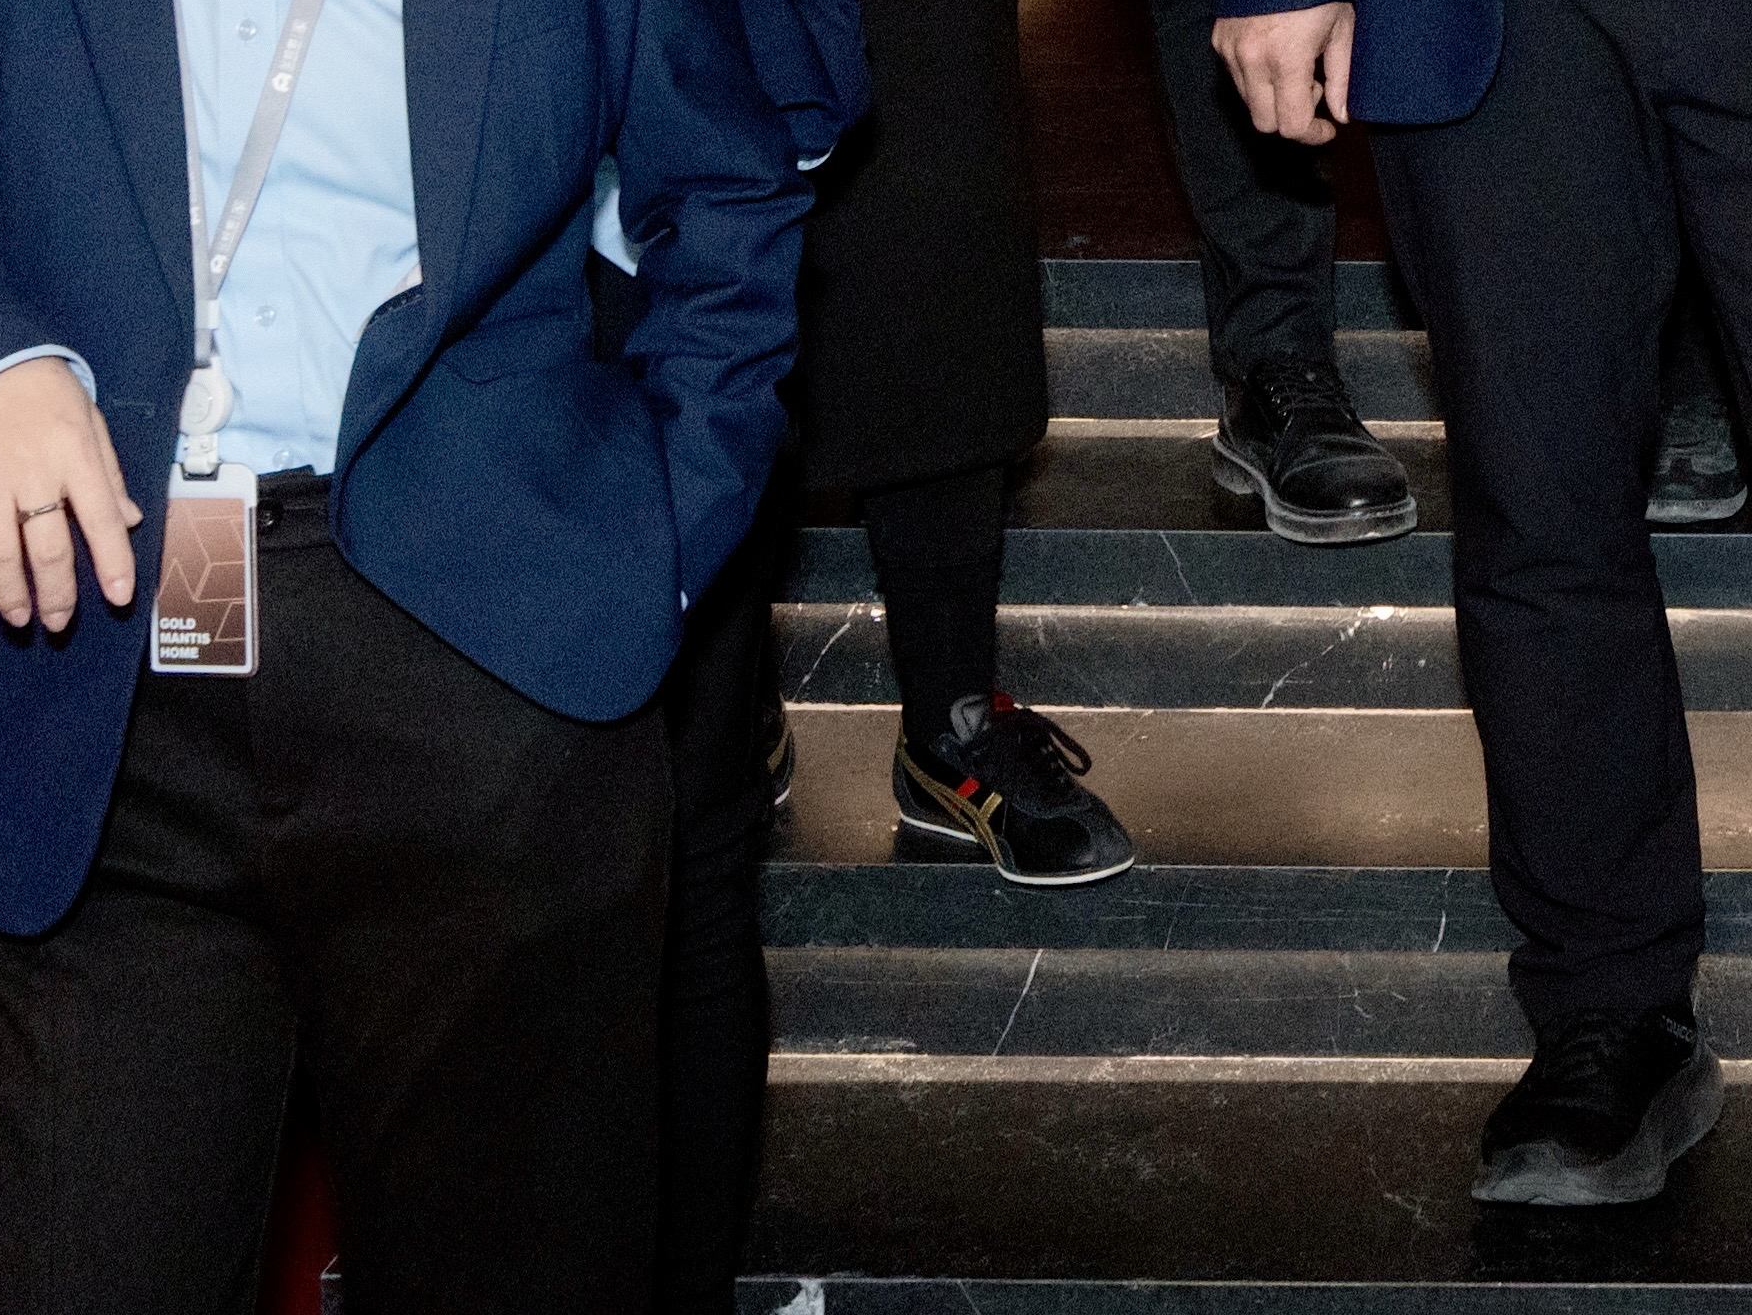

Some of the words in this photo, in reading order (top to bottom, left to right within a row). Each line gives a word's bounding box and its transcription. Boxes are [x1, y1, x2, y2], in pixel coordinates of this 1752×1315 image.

[159, 617, 197, 630] GOLD
[159, 632, 212, 645] MANTIS
[159, 646, 200, 659] HOME
